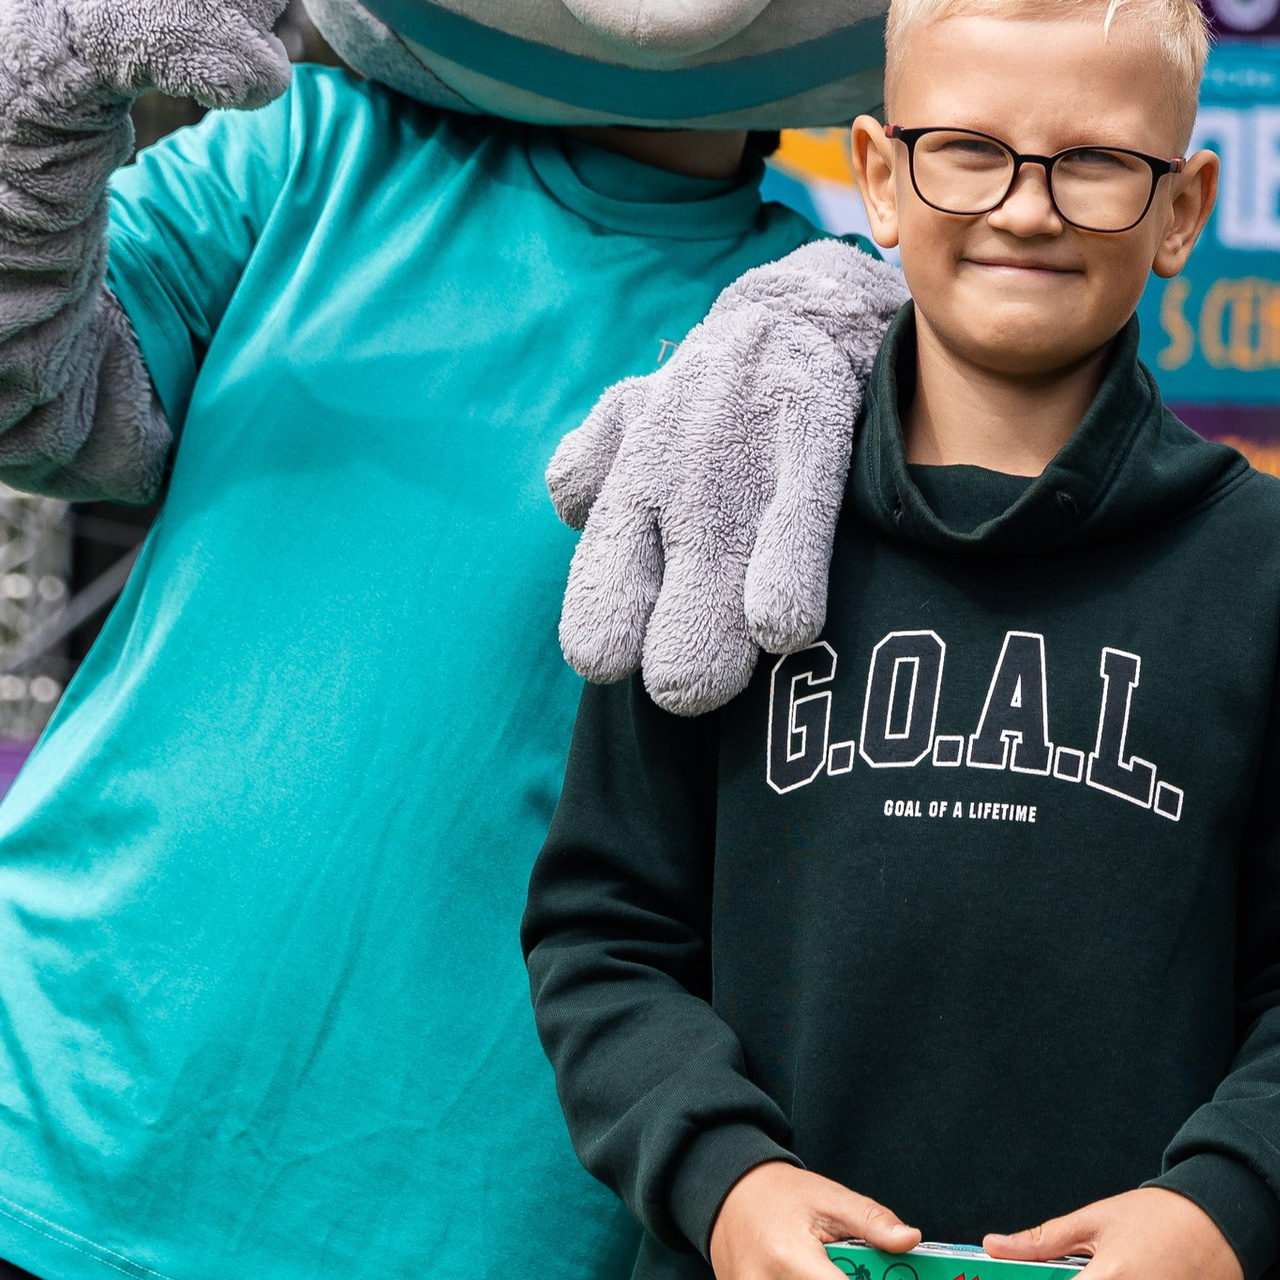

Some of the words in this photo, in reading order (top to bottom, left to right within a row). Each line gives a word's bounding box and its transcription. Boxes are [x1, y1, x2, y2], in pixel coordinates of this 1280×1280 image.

[766, 630, 1184, 822] G.O.A.L.
[883, 799, 922, 818] GOAL
[928, 800, 948, 819] OF
[952, 801, 963, 819] A
[969, 802, 1037, 822] LIFETIME
